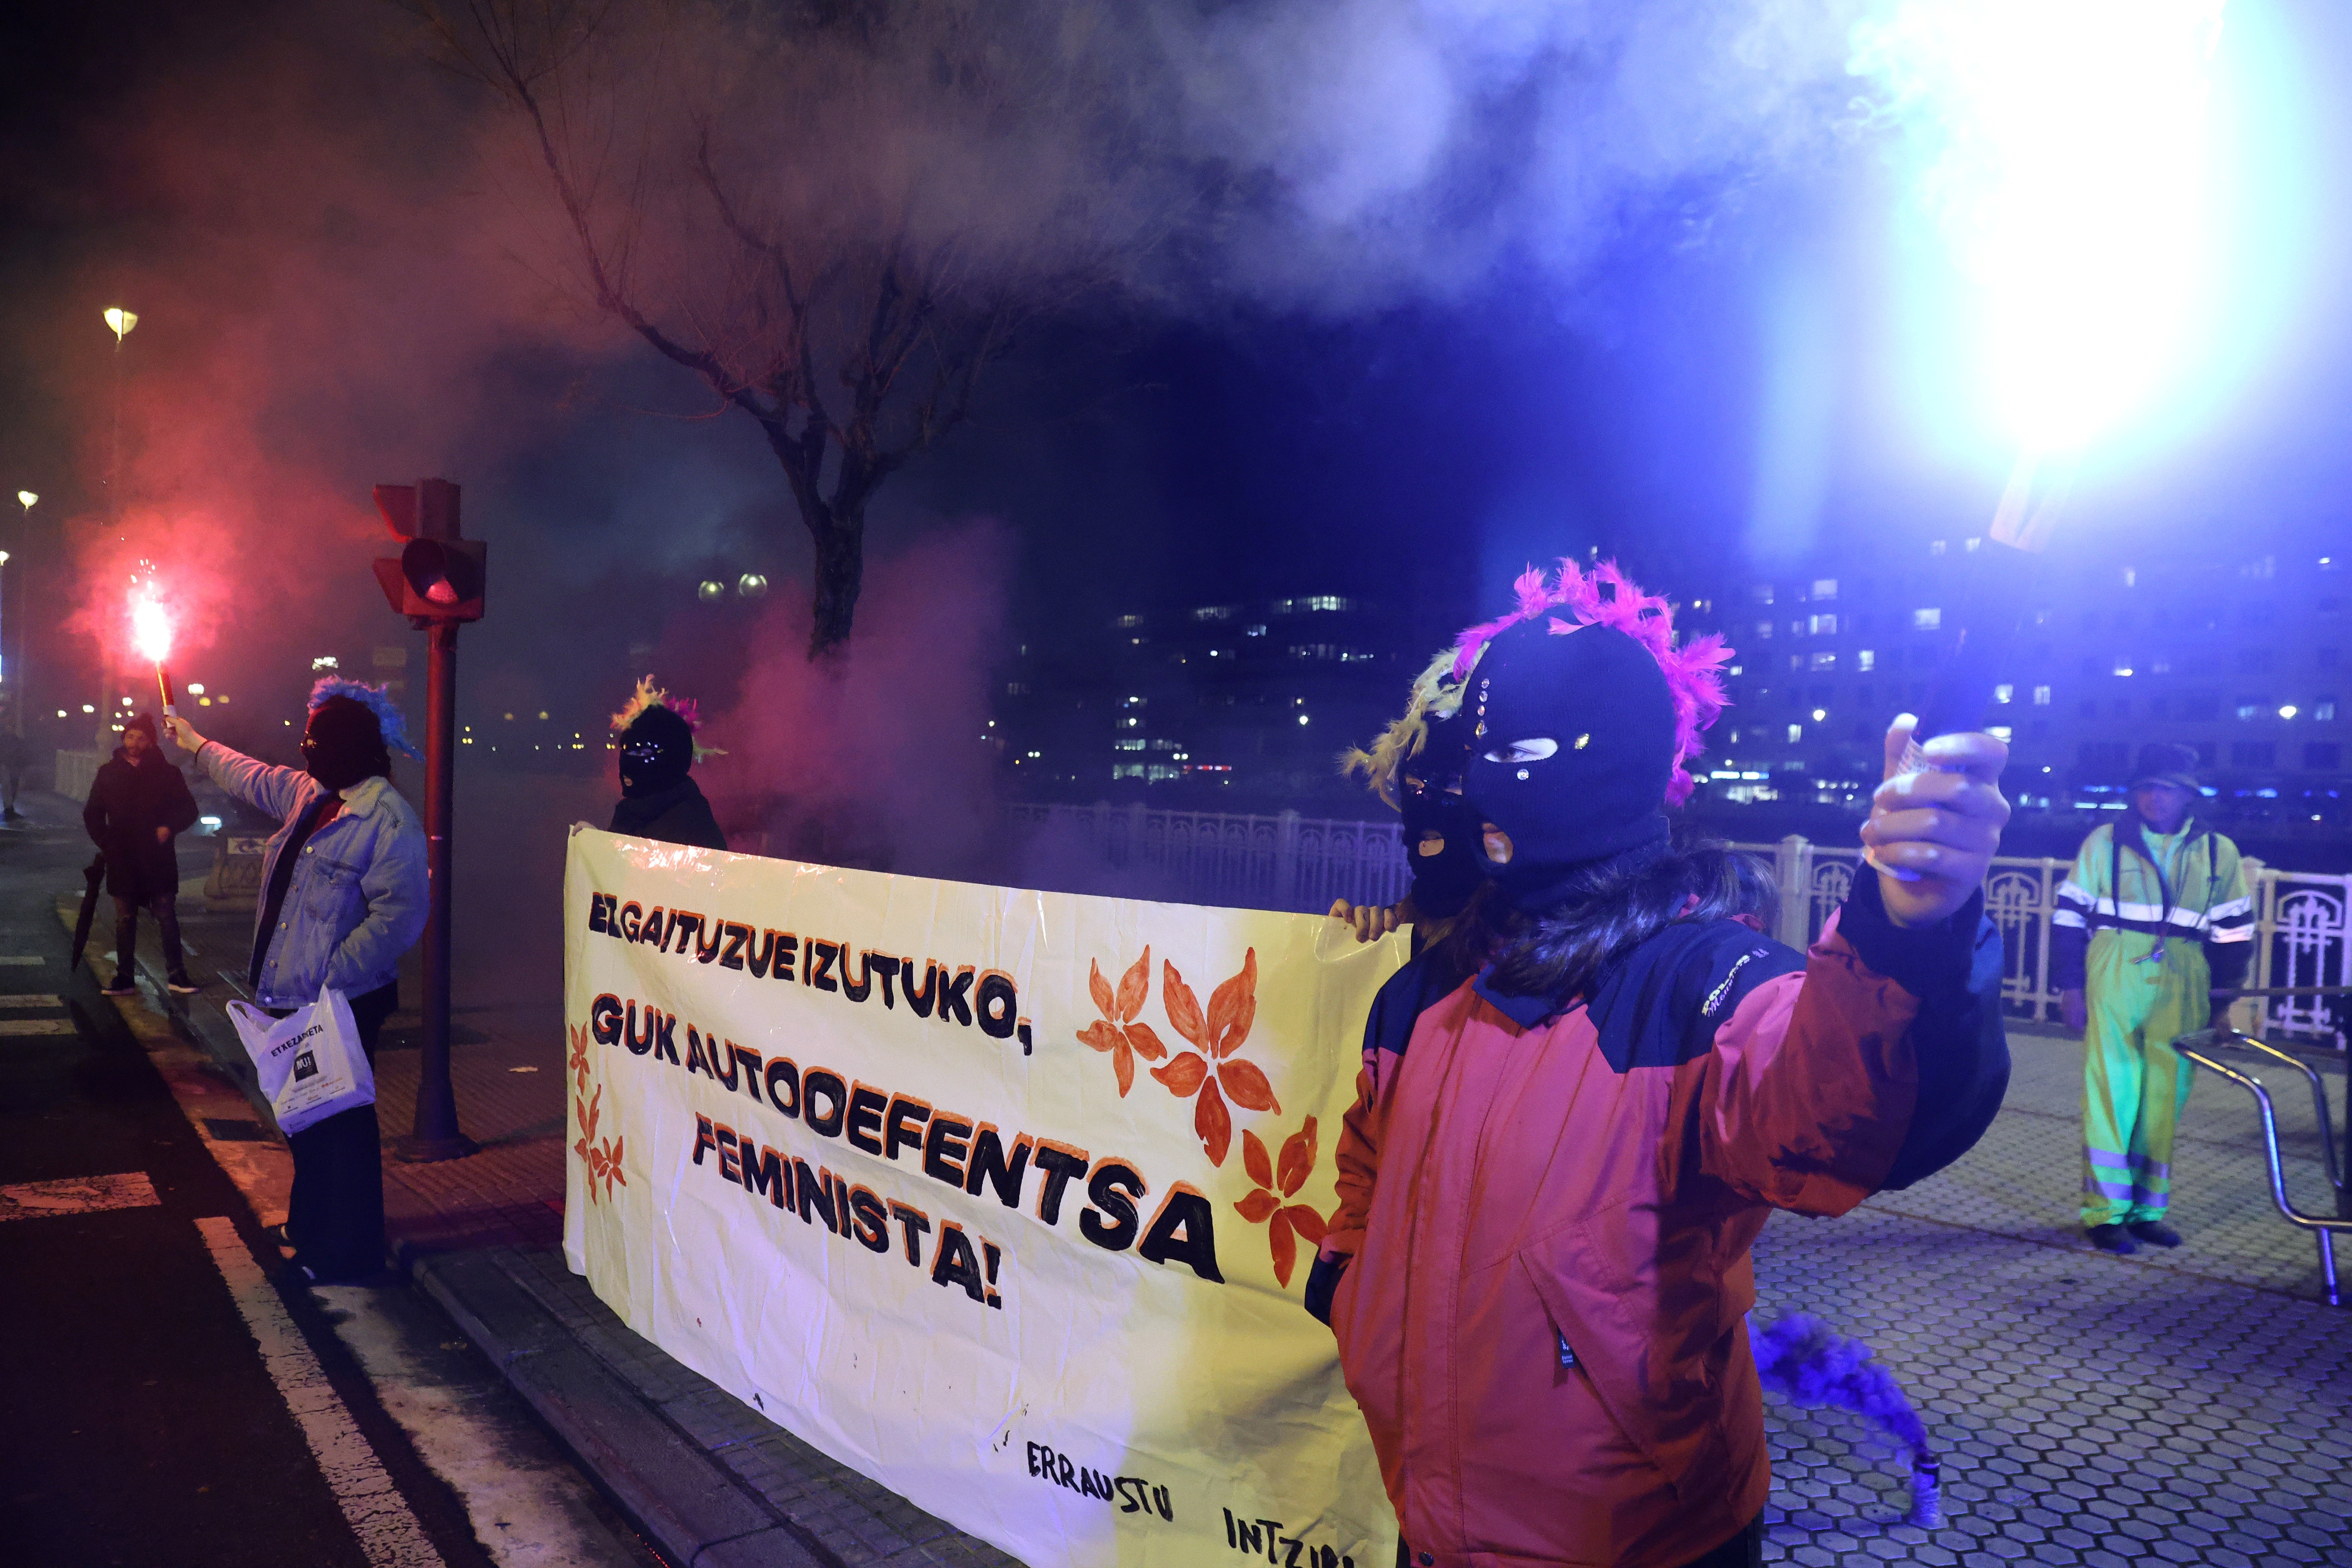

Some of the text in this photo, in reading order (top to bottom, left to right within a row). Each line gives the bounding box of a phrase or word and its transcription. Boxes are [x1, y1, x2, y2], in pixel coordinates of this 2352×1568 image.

[802, 937, 1032, 1056] IZUTUKO,
[591, 993, 1226, 1285] GUK AUTODEFENTSA
[693, 1112, 1002, 1310] FEMINISTA!
[1027, 1441, 1174, 1522] ERRAUSTU
